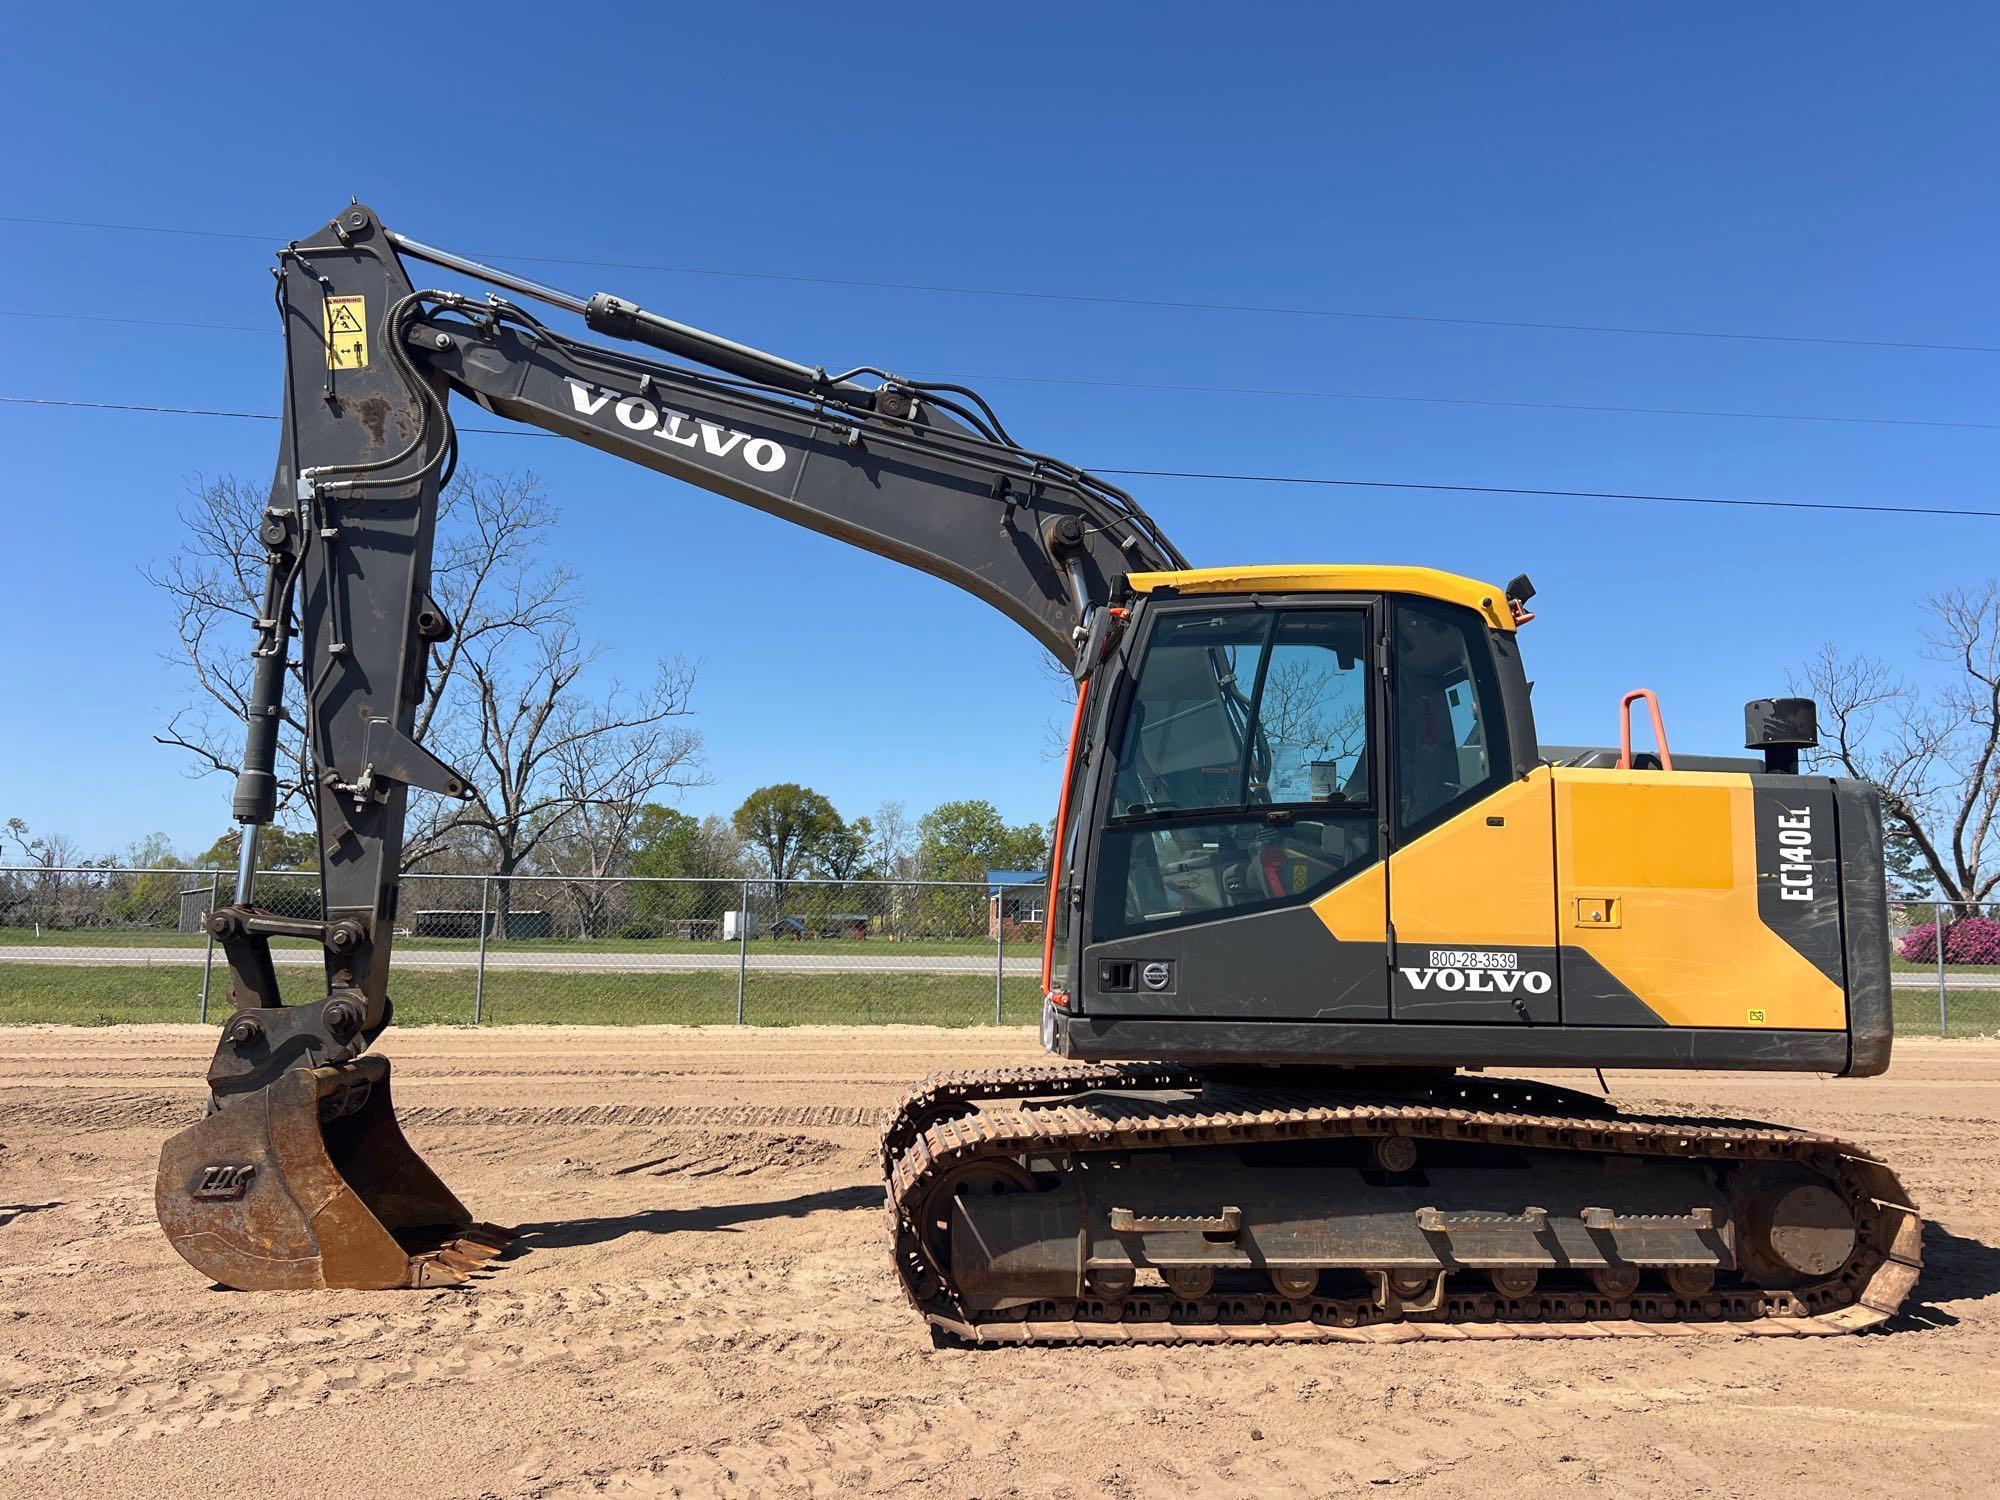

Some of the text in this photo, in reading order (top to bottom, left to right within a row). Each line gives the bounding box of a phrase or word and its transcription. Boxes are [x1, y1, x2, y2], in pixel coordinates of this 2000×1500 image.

[563, 376, 787, 473] VOLVO
[1778, 806, 1814, 901] EC140EL
[1399, 967, 1552, 994] VOLVO
[1431, 951, 1516, 969] 800-28-3539
